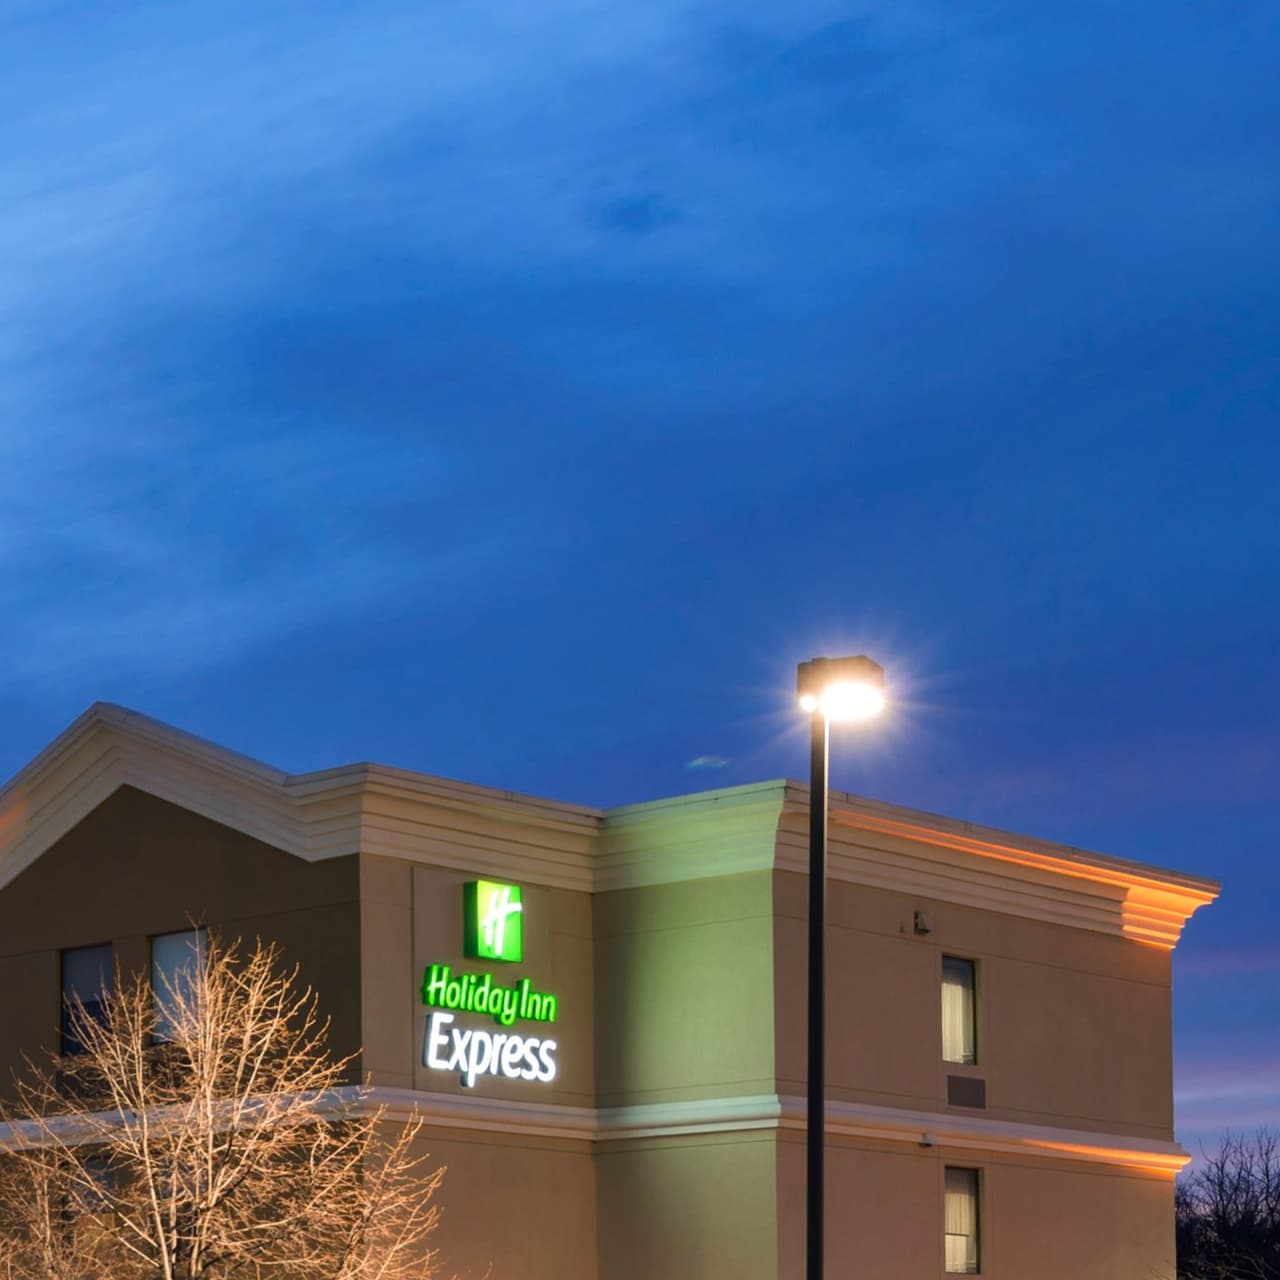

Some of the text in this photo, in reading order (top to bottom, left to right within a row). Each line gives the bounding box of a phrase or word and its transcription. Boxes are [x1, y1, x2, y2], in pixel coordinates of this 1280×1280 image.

[425, 964, 557, 1025] Holiday Inn
[426, 1011, 557, 1087] Express
